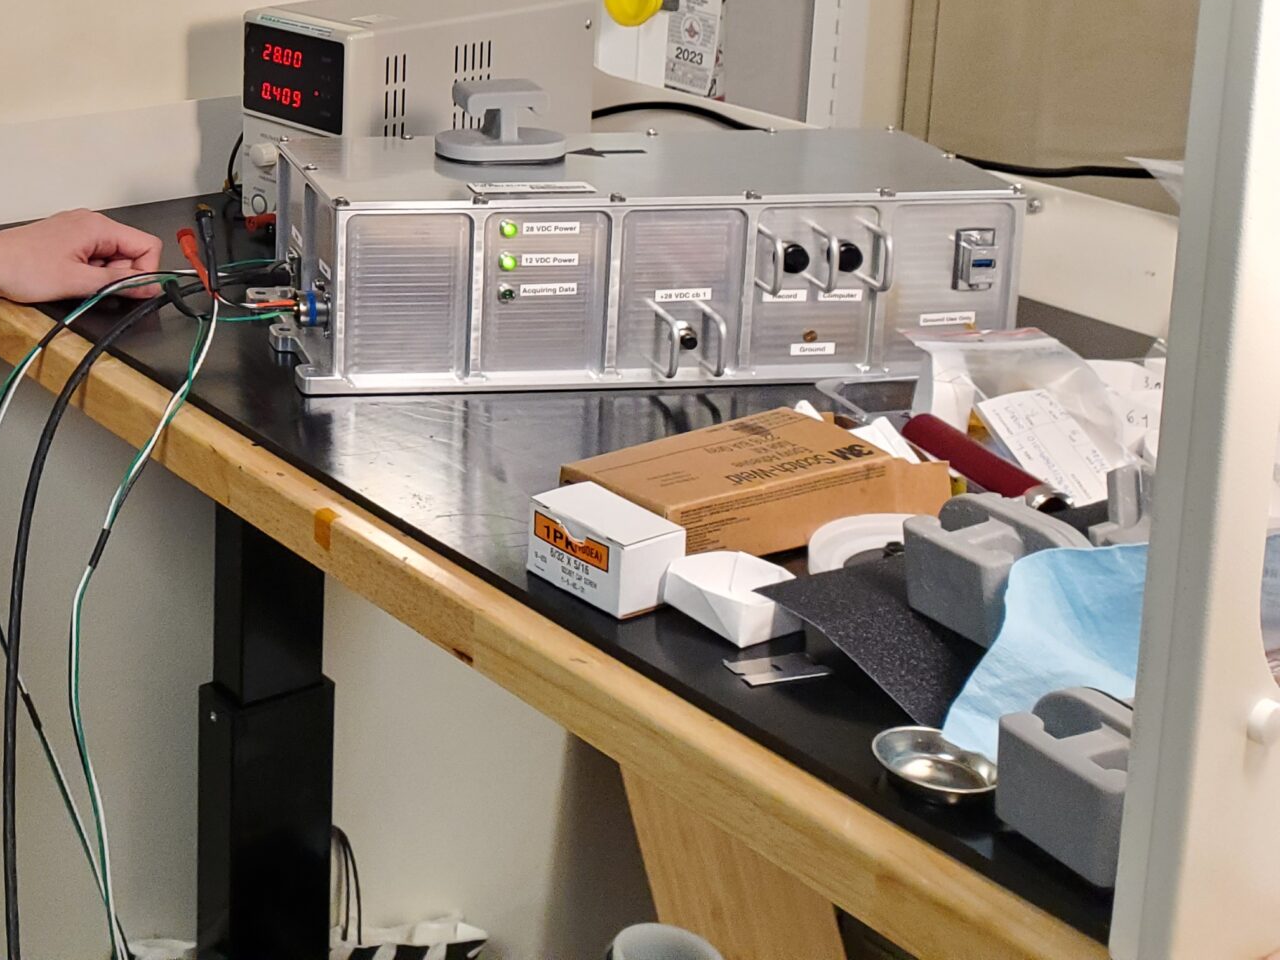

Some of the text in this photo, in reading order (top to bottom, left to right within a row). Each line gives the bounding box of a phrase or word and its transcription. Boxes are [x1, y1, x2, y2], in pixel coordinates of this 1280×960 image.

[262, 43, 303, 68] 28.00
[675, 46, 703, 65] 2023
[261, 82, 302, 108] 0.409
[522, 286, 557, 294] Acquiring
[822, 292, 857, 300] Computer
[828, 444, 874, 461] 3M
